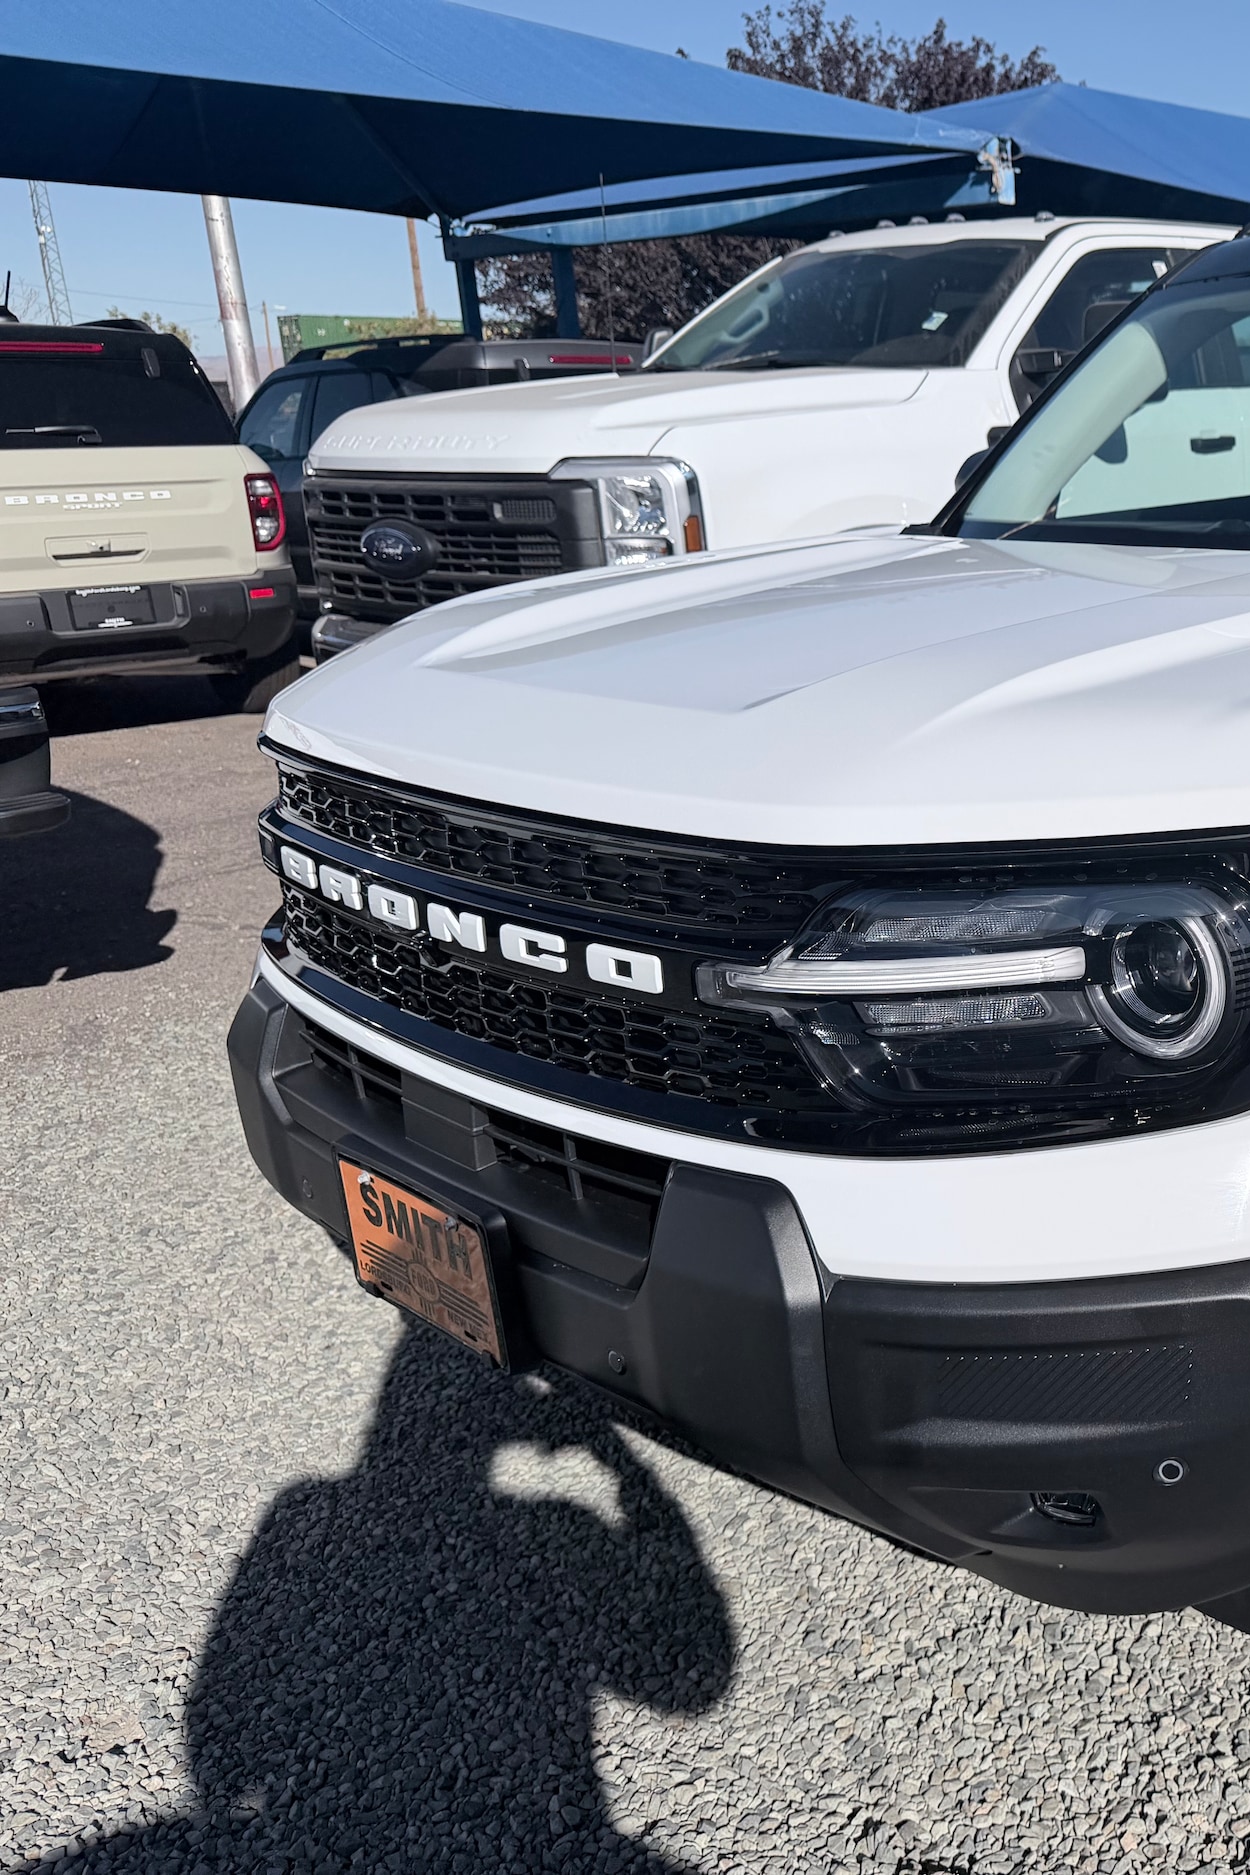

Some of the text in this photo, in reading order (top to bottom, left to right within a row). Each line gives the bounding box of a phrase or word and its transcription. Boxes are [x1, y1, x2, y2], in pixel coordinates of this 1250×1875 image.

[4, 490, 172, 505] BRONCO
[280, 845, 664, 995] BRONCO
[360, 1183, 473, 1280] SMITH
[411, 1269, 435, 1295] FORD
